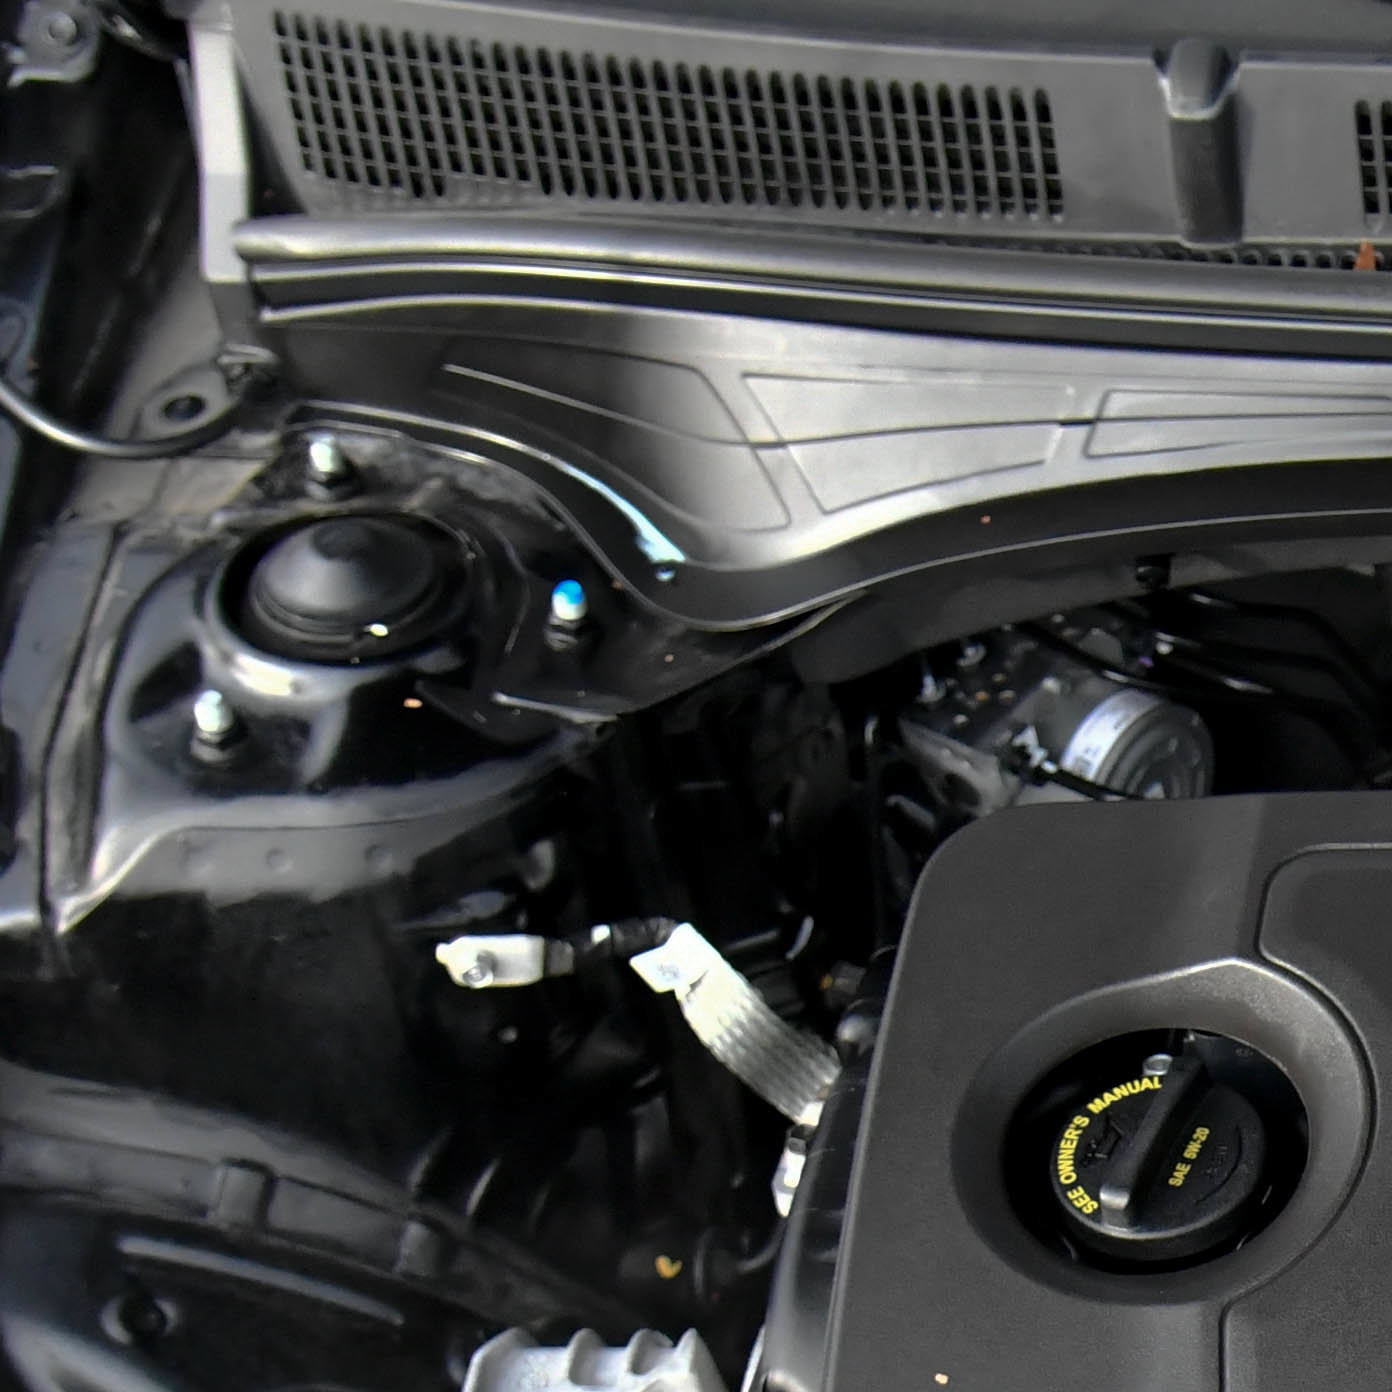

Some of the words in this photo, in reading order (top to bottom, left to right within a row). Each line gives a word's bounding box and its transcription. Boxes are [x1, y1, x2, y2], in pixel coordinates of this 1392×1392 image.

[1086, 1076, 1162, 1115] MANUAL
[1058, 1115, 1090, 1185] OWNER'S
[1168, 1163, 1191, 1187] SAE
[1184, 1127, 1210, 1160] 5W-20
[1066, 1185, 1099, 1214] SEE
